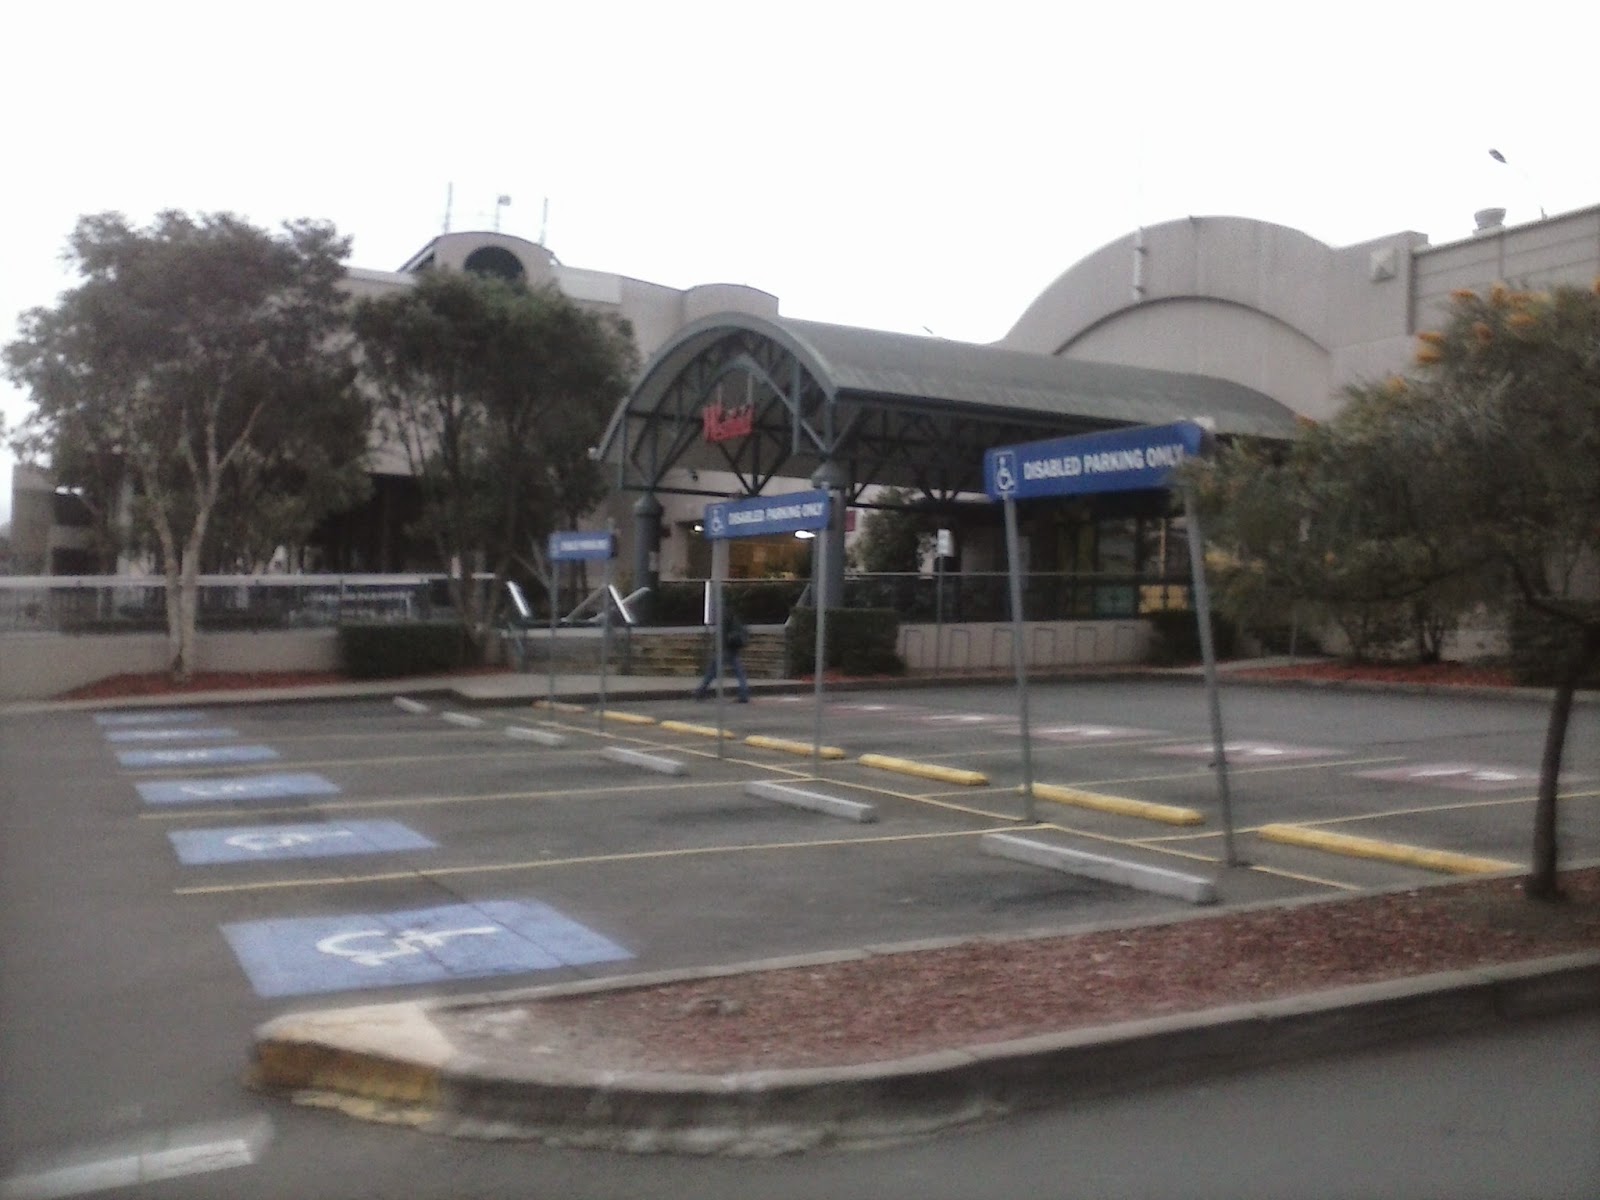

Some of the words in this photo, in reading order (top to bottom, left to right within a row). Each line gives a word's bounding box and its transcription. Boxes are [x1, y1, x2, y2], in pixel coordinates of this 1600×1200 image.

[1023, 456, 1081, 480] DISABLED
[1083, 449, 1144, 474] PARKING
[1146, 444, 1184, 468] ONLY
